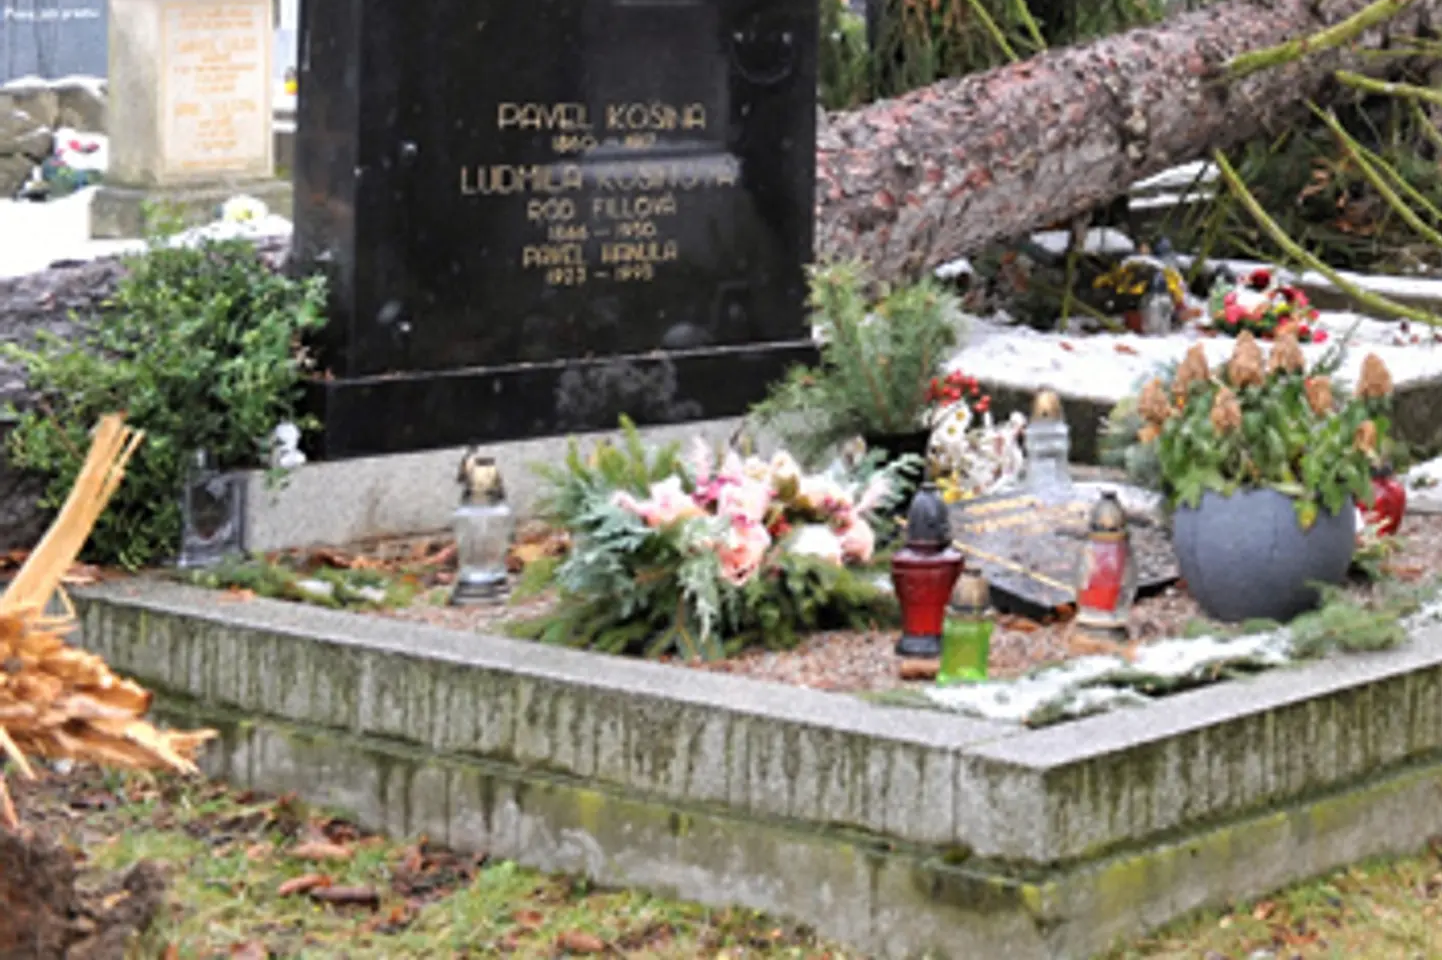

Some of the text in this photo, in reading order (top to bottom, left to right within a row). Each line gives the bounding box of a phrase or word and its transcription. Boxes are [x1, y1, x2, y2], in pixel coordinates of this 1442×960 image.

[498, 103, 594, 130] PAVEL
[460, 164, 583, 195] LUDMILA
[522, 242, 587, 268] PAVEL
